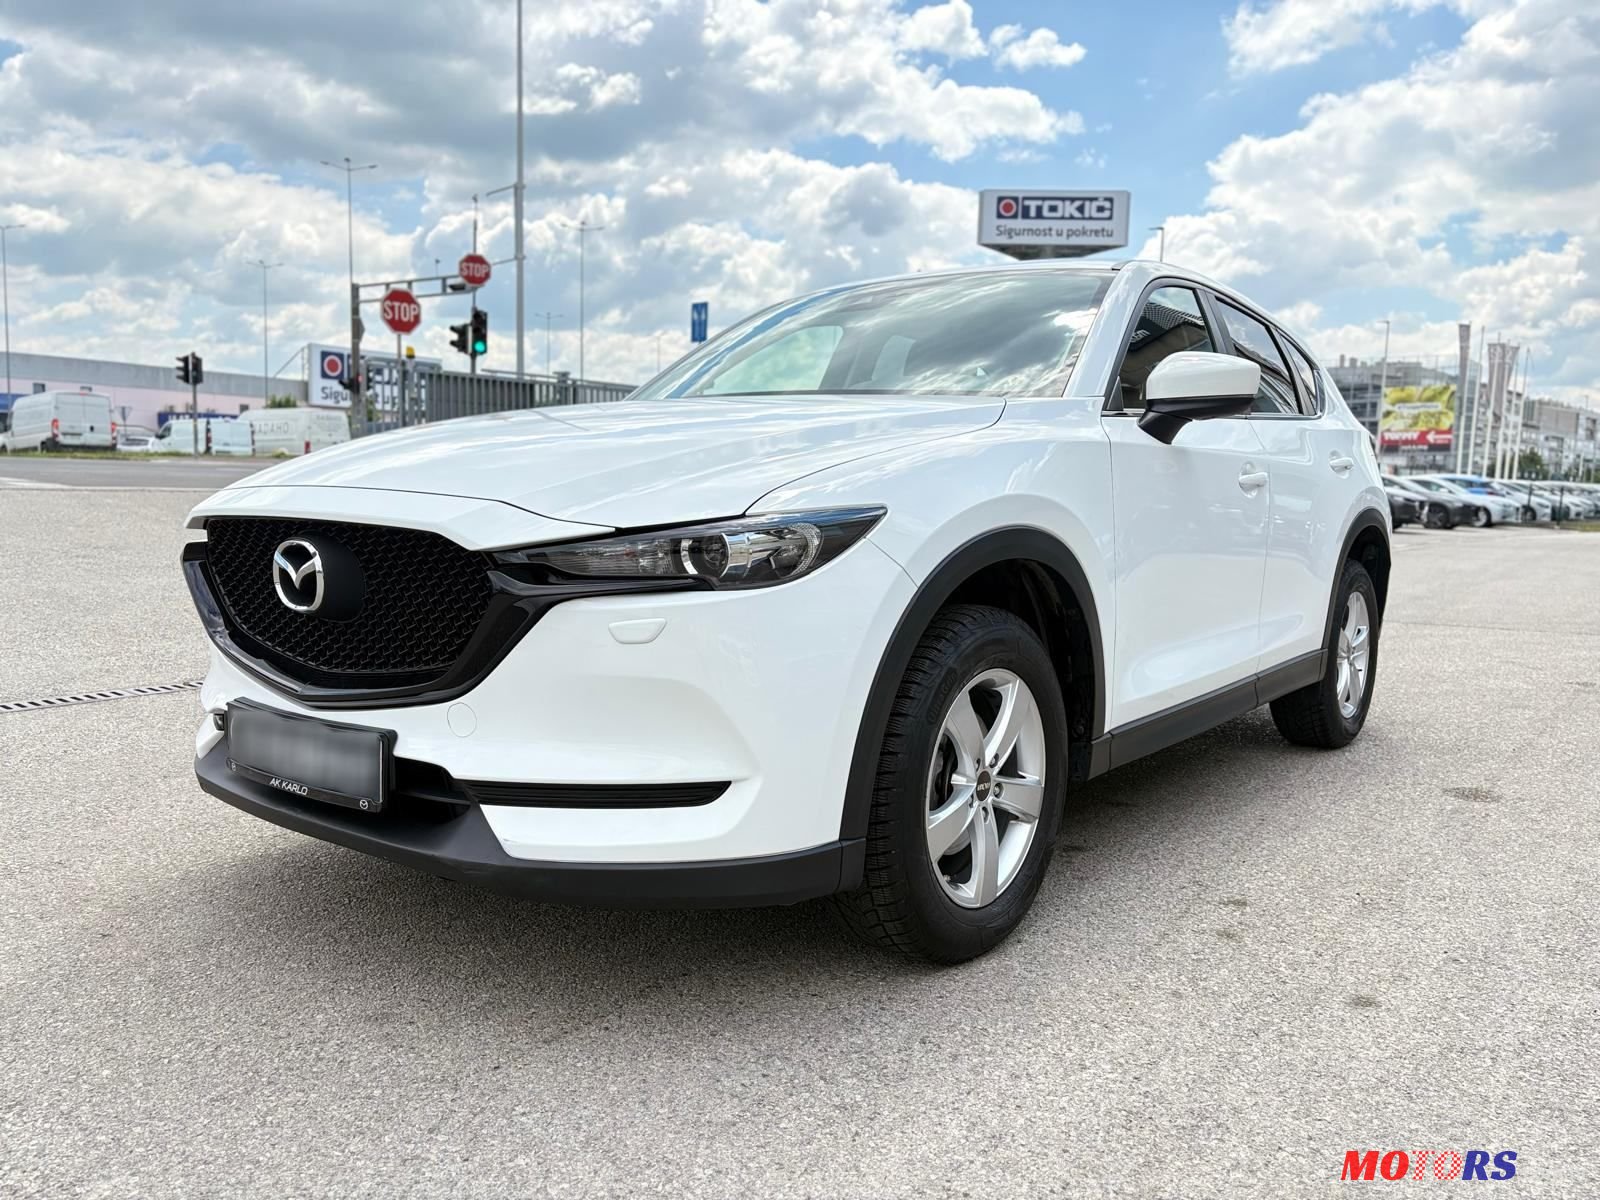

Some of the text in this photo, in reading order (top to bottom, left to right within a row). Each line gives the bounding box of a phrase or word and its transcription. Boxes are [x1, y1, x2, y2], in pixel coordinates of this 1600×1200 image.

[1023, 197, 1112, 218] TOKIĆ
[995, 225, 1114, 239] Sigurnost u pokretu
[461, 262, 489, 278] STOP
[383, 300, 419, 322] STOP
[269, 777, 309, 796] AK KARLO
